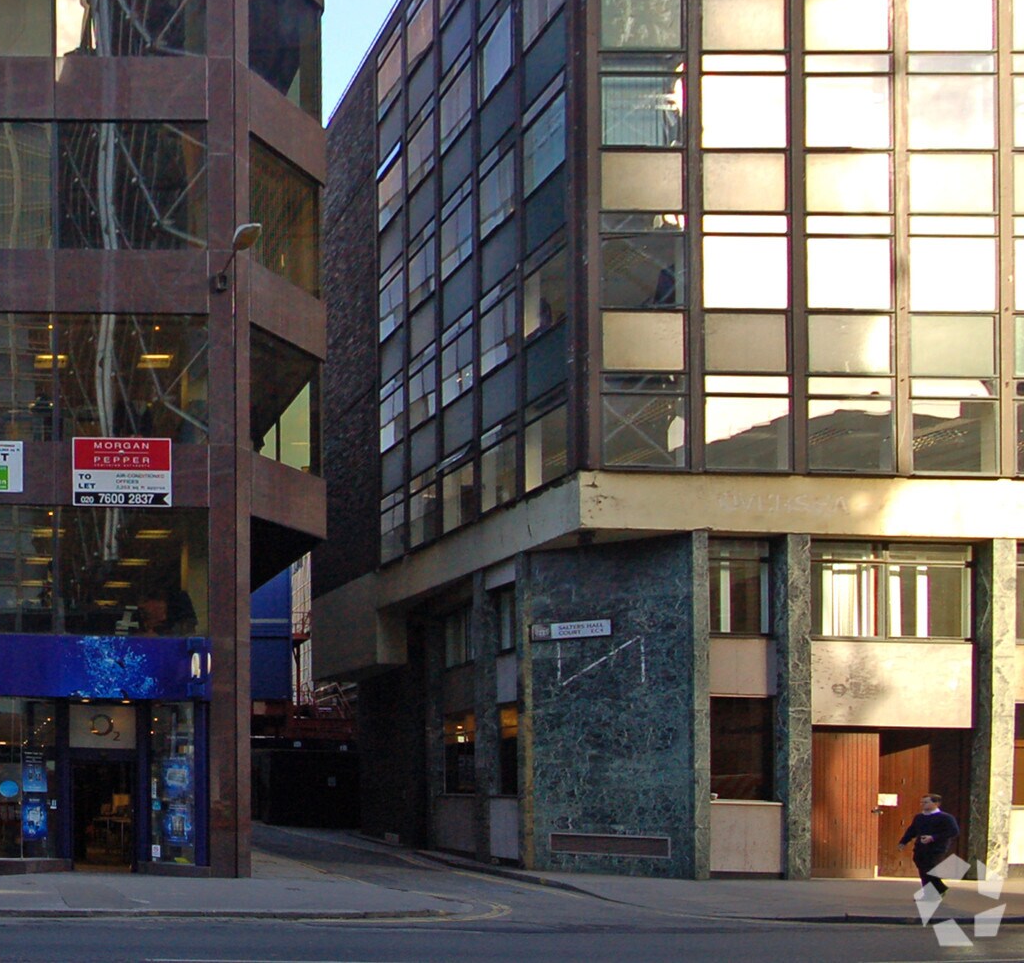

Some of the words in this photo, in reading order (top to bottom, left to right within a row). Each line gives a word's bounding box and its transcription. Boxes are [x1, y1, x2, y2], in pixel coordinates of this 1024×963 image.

[93, 441, 150, 450] MORGAN
[93, 456, 150, 464] PEPPER
[79, 473, 92, 481] TO
[80, 495, 95, 504] 020
[98, 493, 125, 504] 7600
[128, 493, 155, 505] 2837
